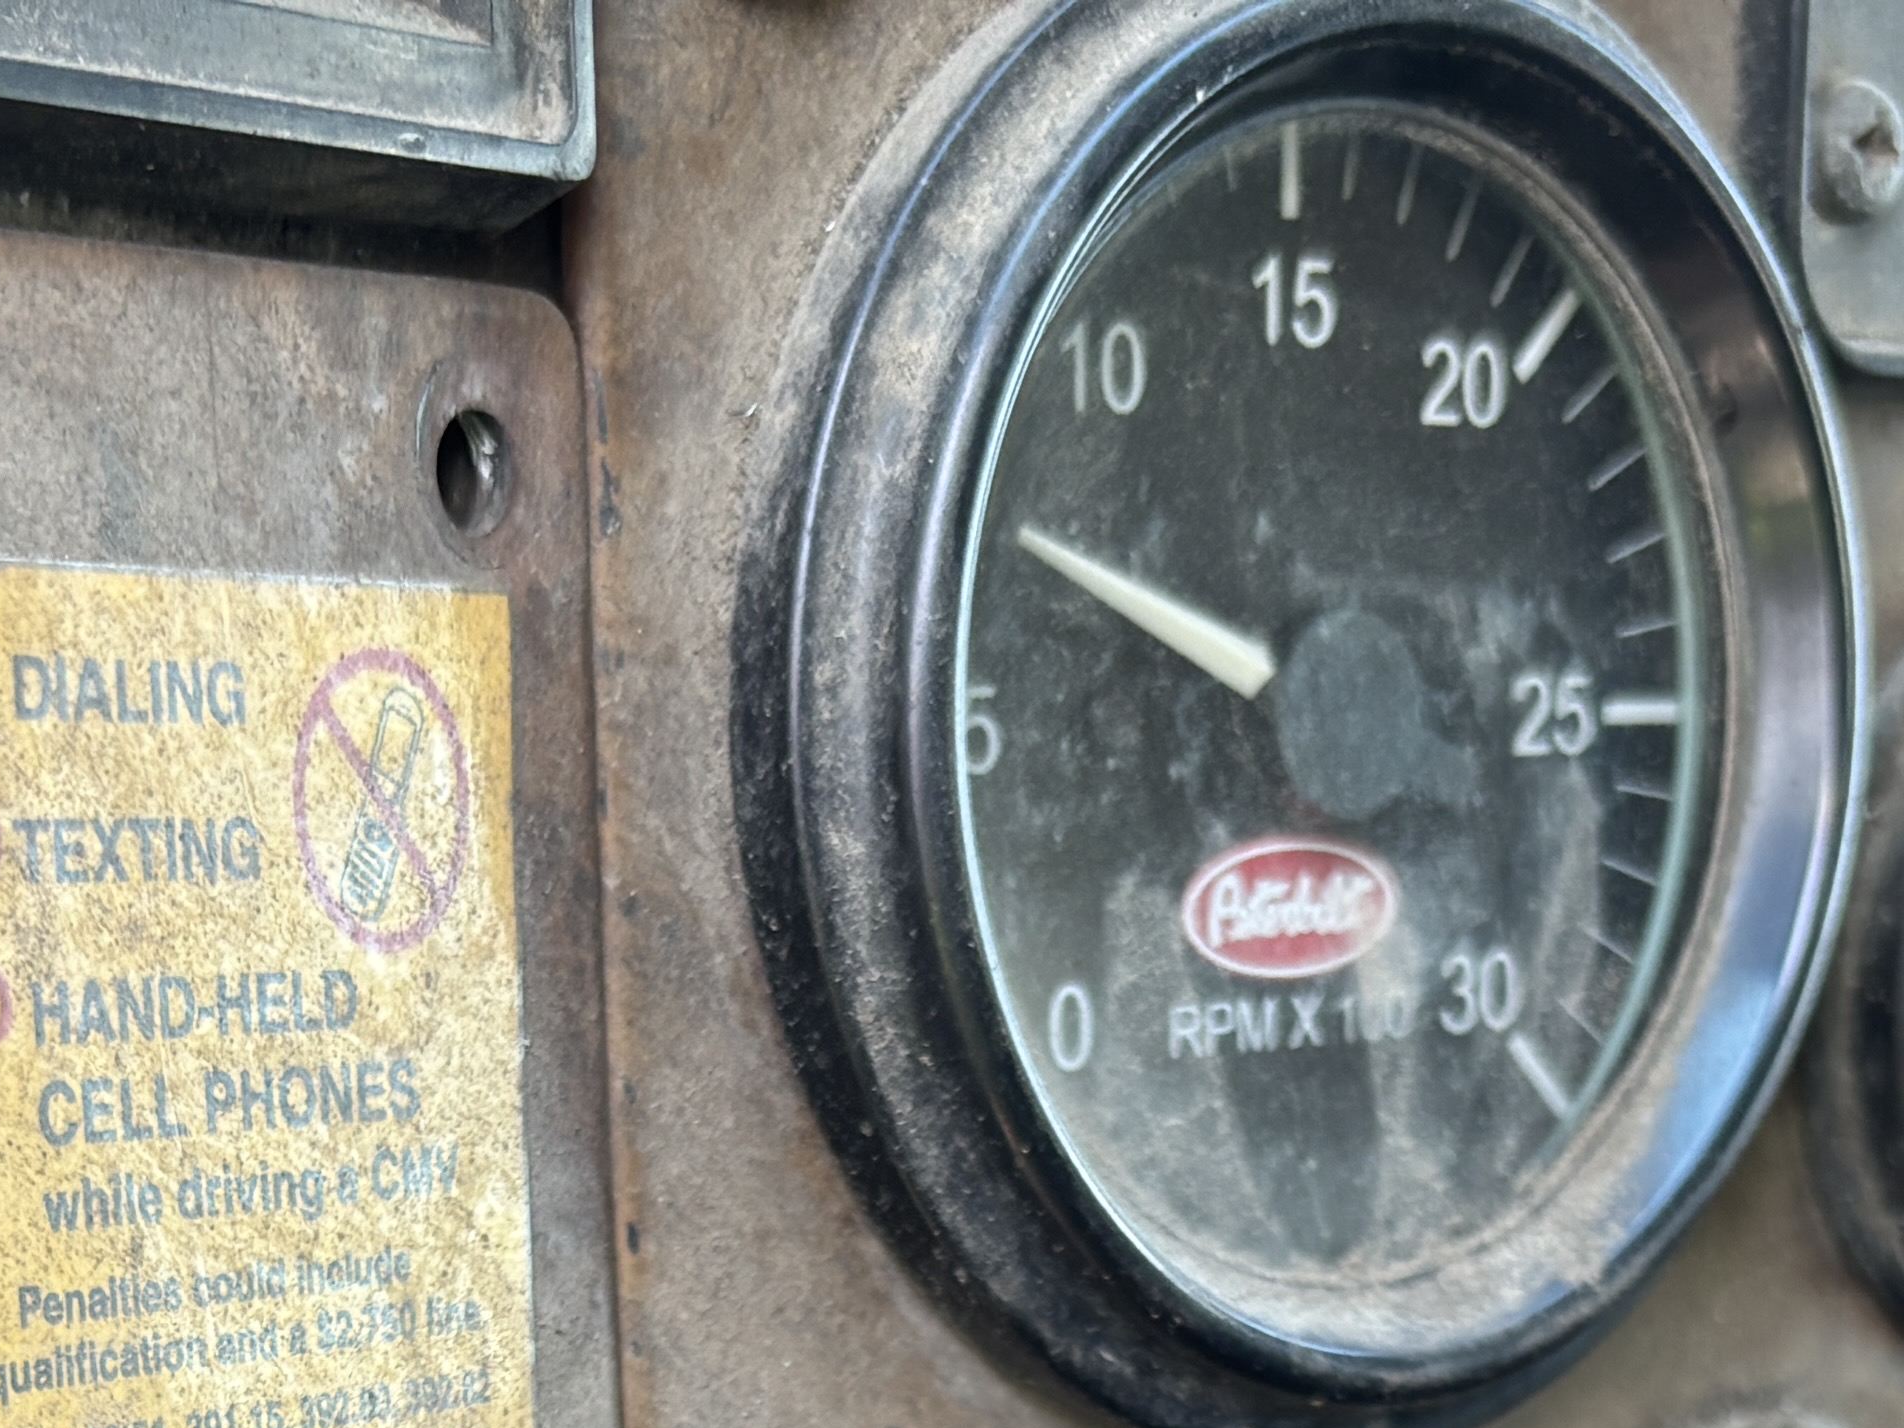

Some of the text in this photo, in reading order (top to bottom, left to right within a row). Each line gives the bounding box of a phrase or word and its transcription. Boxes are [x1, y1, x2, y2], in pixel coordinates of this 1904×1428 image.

[1252, 256, 1339, 349] 15
[1063, 322, 1148, 414] 10
[1419, 339, 1501, 428] 20
[11, 652, 248, 728] DIALING
[965, 684, 1002, 775] 5
[1511, 671, 1595, 757] 25
[11, 815, 263, 886] TEXTING
[30, 967, 359, 1049] HAND-HELD
[1047, 985, 1093, 1073] 0
[1168, 997, 1281, 1060] RPM
[1288, 995, 1327, 1050] X
[1440, 947, 1524, 1035] 30
[37, 1057, 423, 1148] CELL PHONES
[42, 1142, 460, 1233] while driving a CMV
[17, 1244, 412, 1330] Penalties could include
[215, 1318, 280, 1366] and
